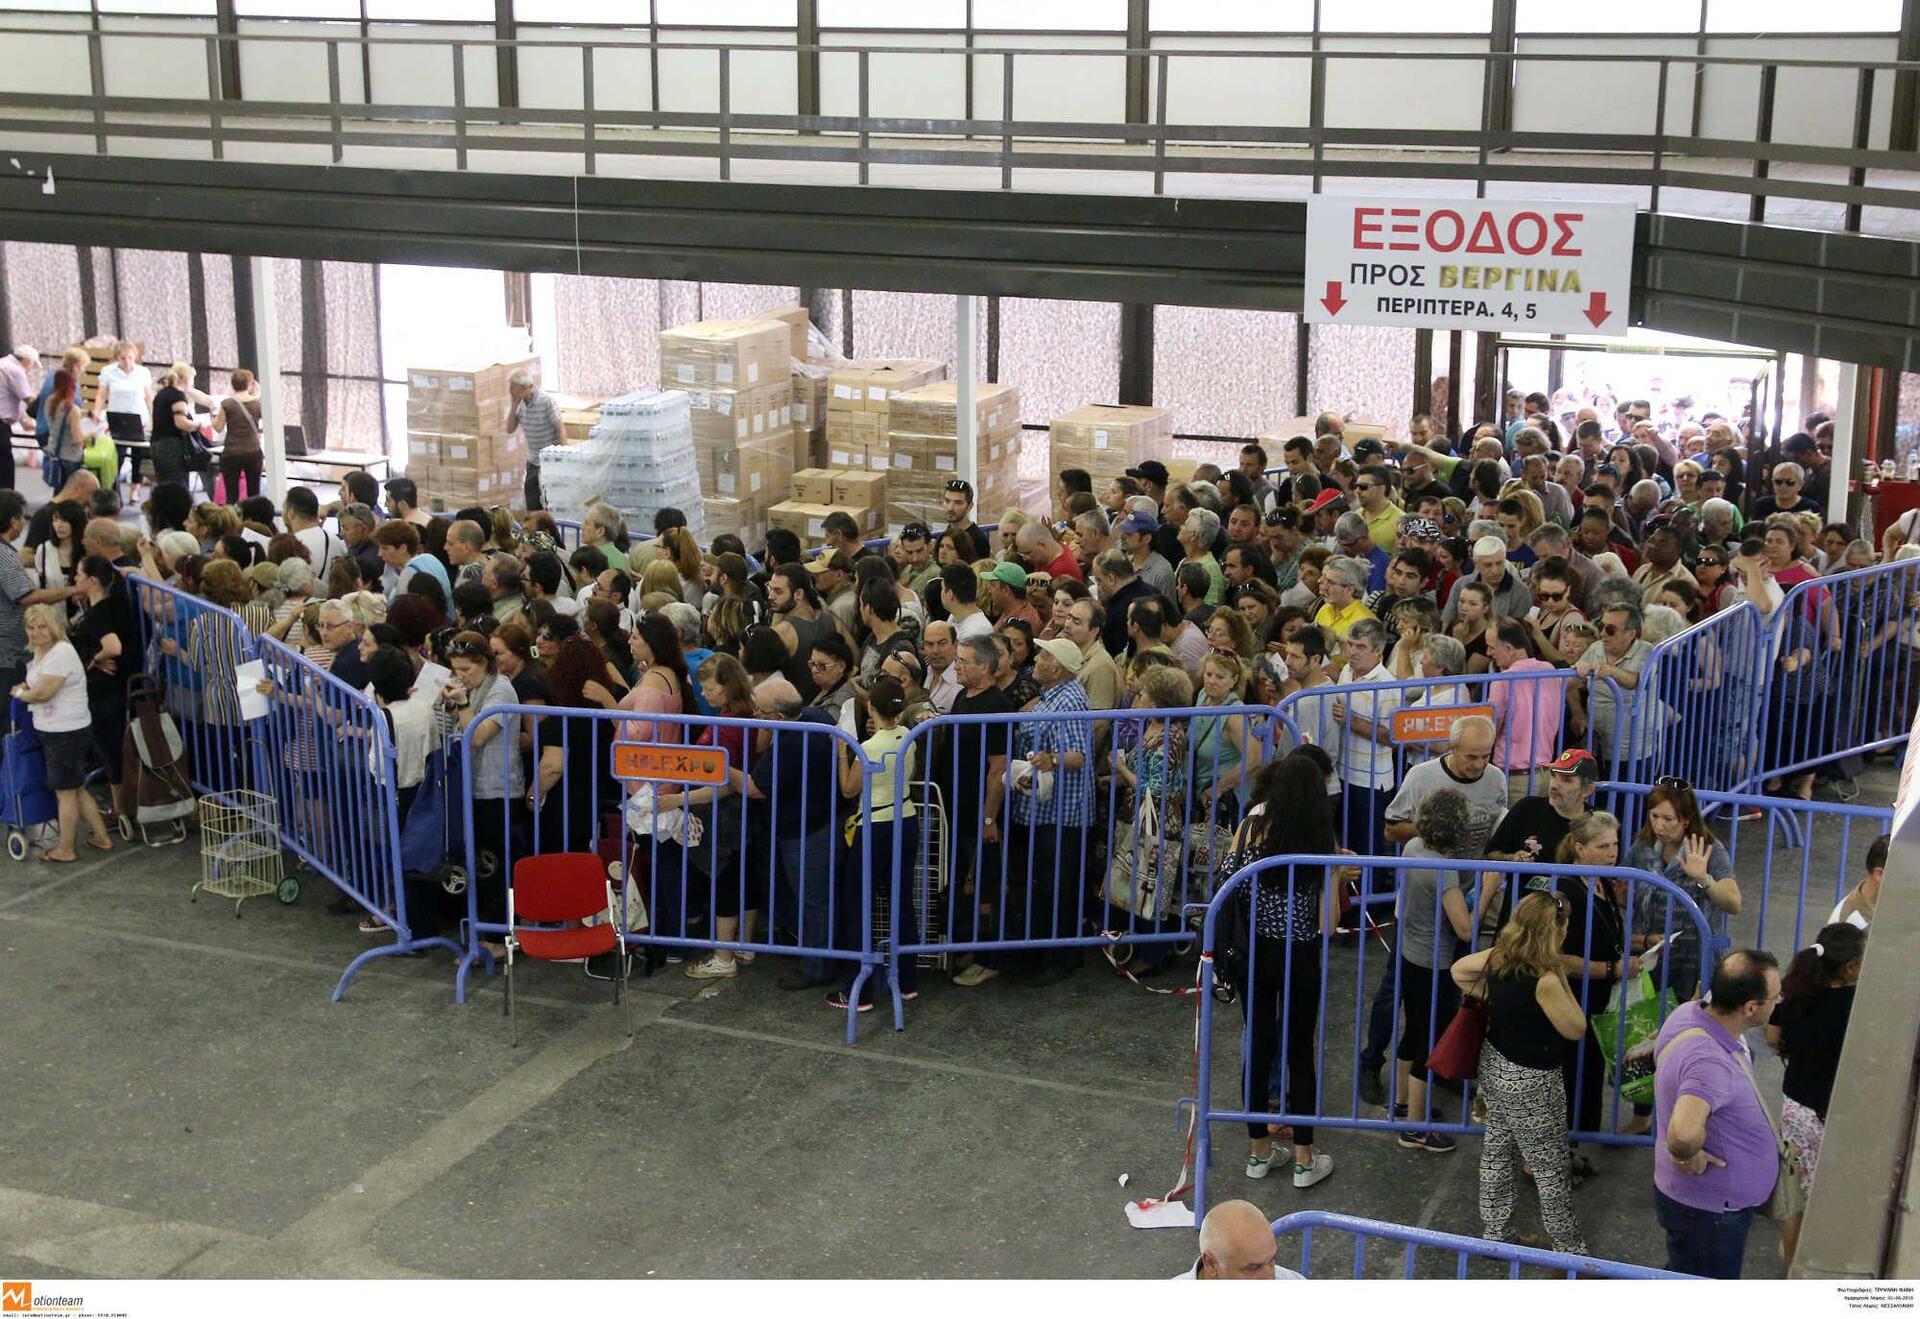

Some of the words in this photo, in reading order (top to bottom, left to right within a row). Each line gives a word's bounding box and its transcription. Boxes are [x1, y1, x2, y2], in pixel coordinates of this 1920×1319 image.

[1353, 207, 1584, 257] ΕΞΟΔΟΣ
[1350, 263, 1426, 287] ΠΡΟΣ
[1439, 265, 1583, 294] ΒΕΡΓΙΝΑ
[1377, 296, 1495, 318] ΠΕΡΙΠΤΕΡΑ.
[1525, 303, 1537, 319] 5
